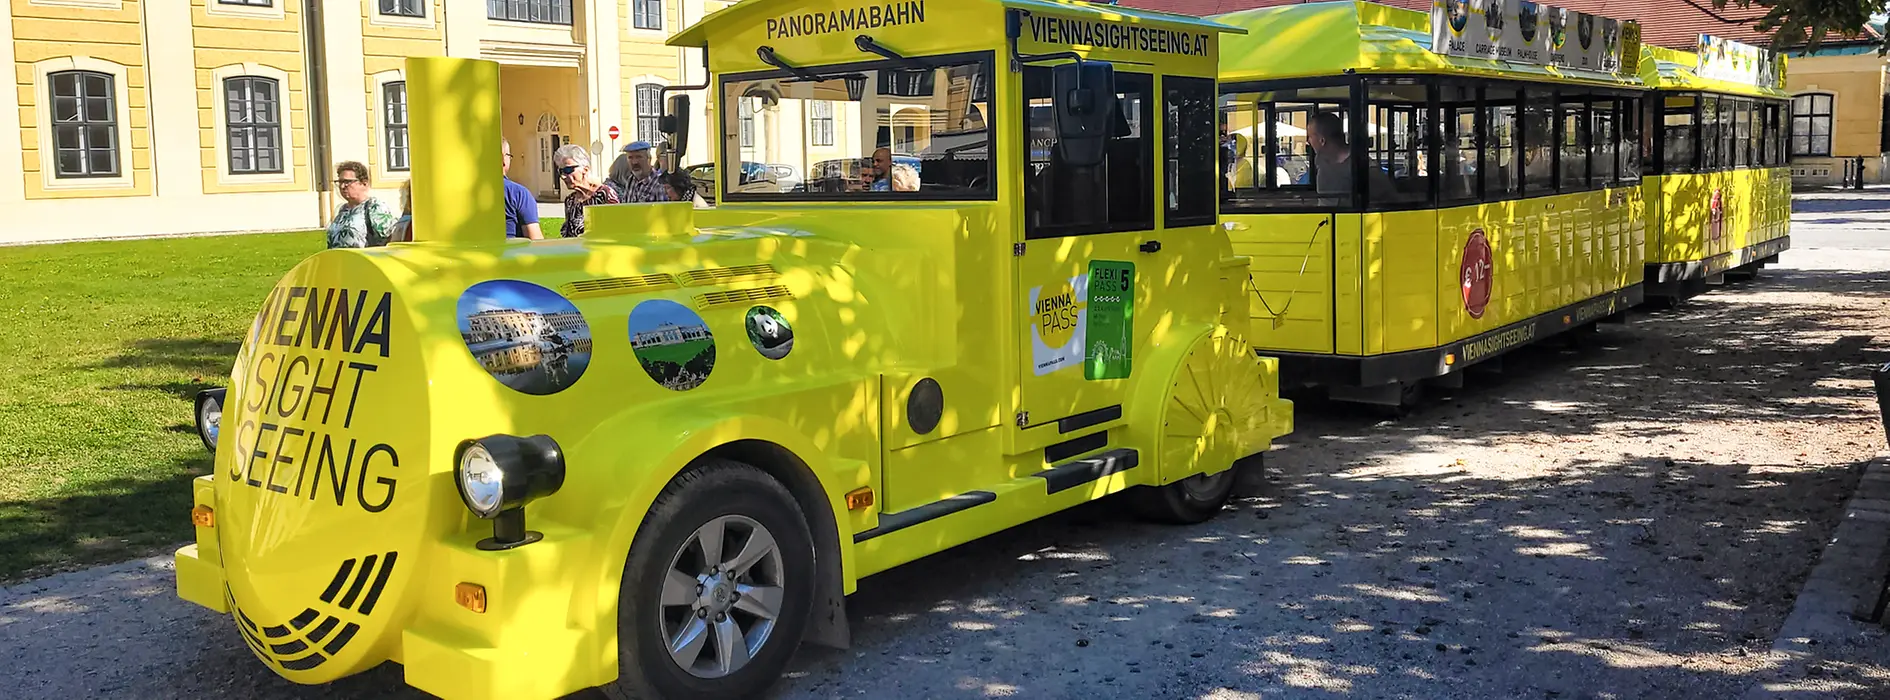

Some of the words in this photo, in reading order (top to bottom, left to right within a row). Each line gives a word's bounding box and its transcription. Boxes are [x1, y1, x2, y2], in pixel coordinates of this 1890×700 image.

[766, 1, 925, 39] PANORAMABAHN
[1029, 15, 1209, 56] VIENNASIGHTSEEING.AT
[1094, 280, 1117, 292] PASS
[1095, 268, 1117, 280] FLEXI
[1121, 269, 1130, 292] 5
[256, 286, 392, 358] VIENNA
[1035, 293, 1072, 315] VIENNA
[1042, 305, 1078, 336] PASS
[1462, 322, 1536, 362] VIENNASIGHTSEEING.AT
[247, 352, 378, 429] SIGHT
[230, 420, 400, 513] SEEING
